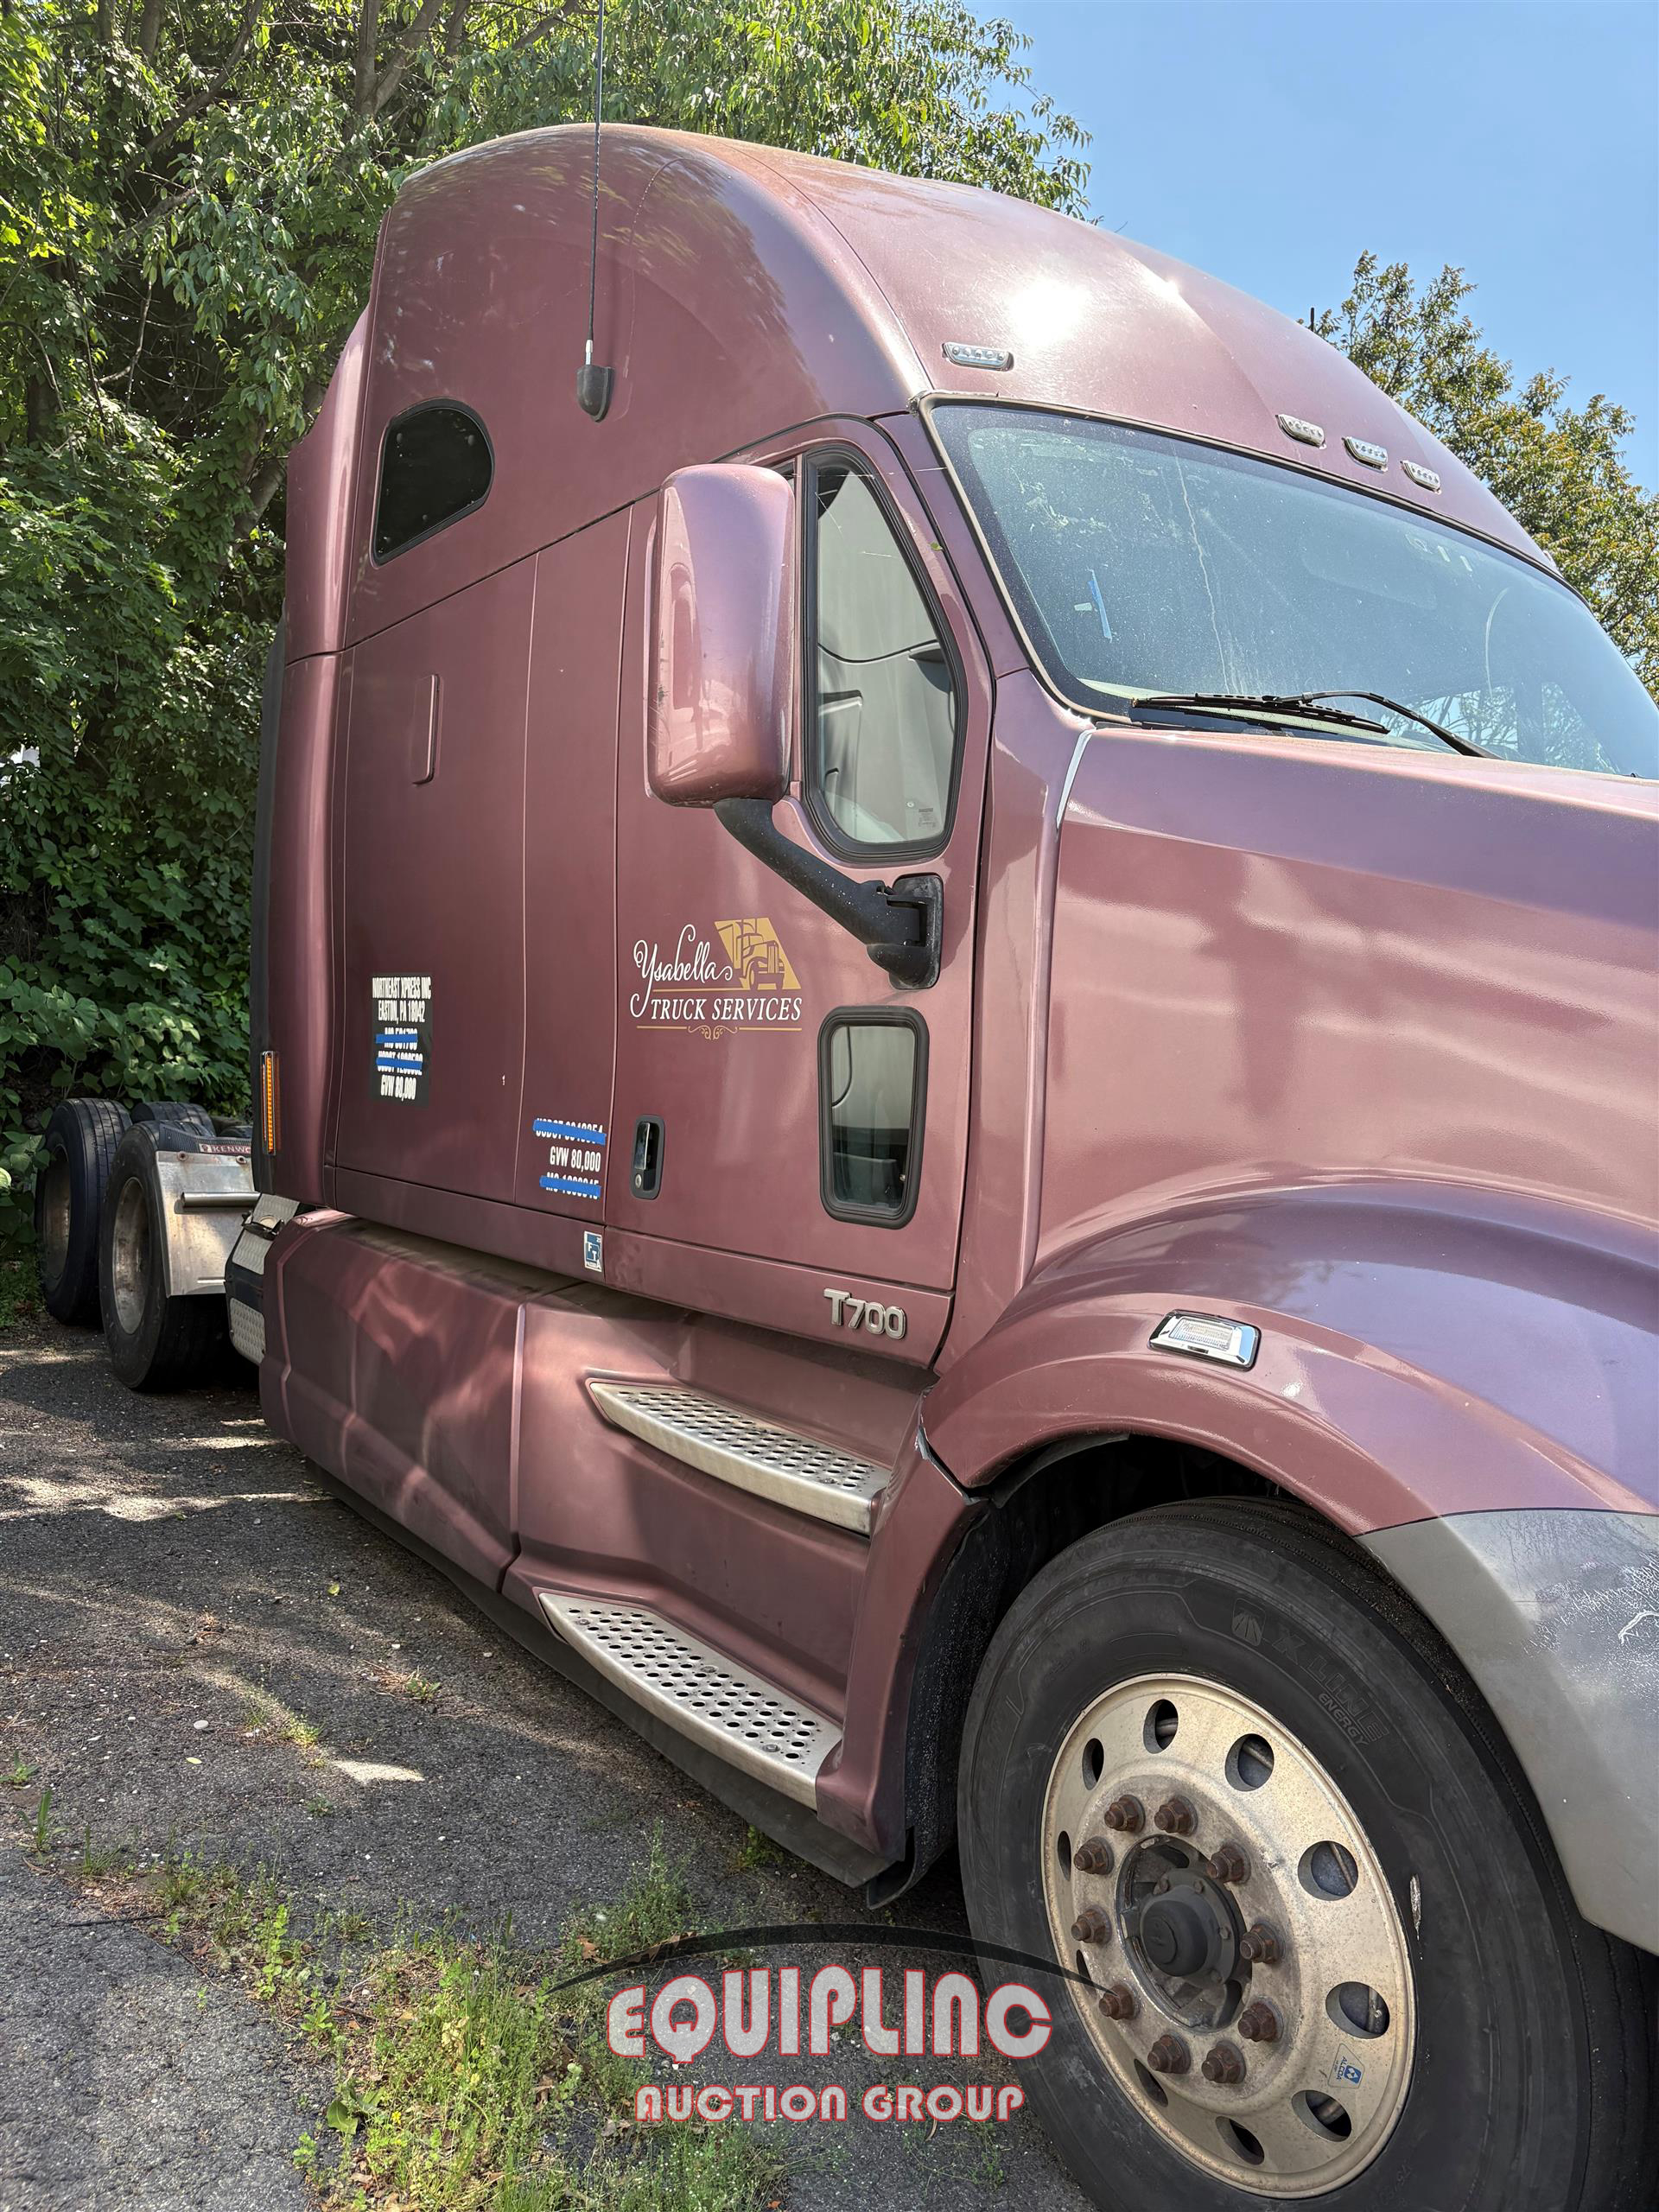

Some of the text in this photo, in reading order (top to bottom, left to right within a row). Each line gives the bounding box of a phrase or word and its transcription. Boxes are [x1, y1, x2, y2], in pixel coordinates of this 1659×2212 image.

[630, 924, 733, 1018] Ysabella
[372, 976, 431, 1000] NORTHEAST XPRESS INC
[378, 1000, 425, 1025] EASTON, PA 18042
[651, 997, 802, 1021] TRUCK SERVICES
[380, 1074, 416, 1102] GVW 80,000
[550, 1146, 601, 1173] GVW 80,000
[823, 1287, 907, 1339] T700
[1307, 1654, 1389, 1741] LINE
[1318, 1693, 1370, 1745] ENERGY
[1336, 2056, 1348, 2080] ALCOA
